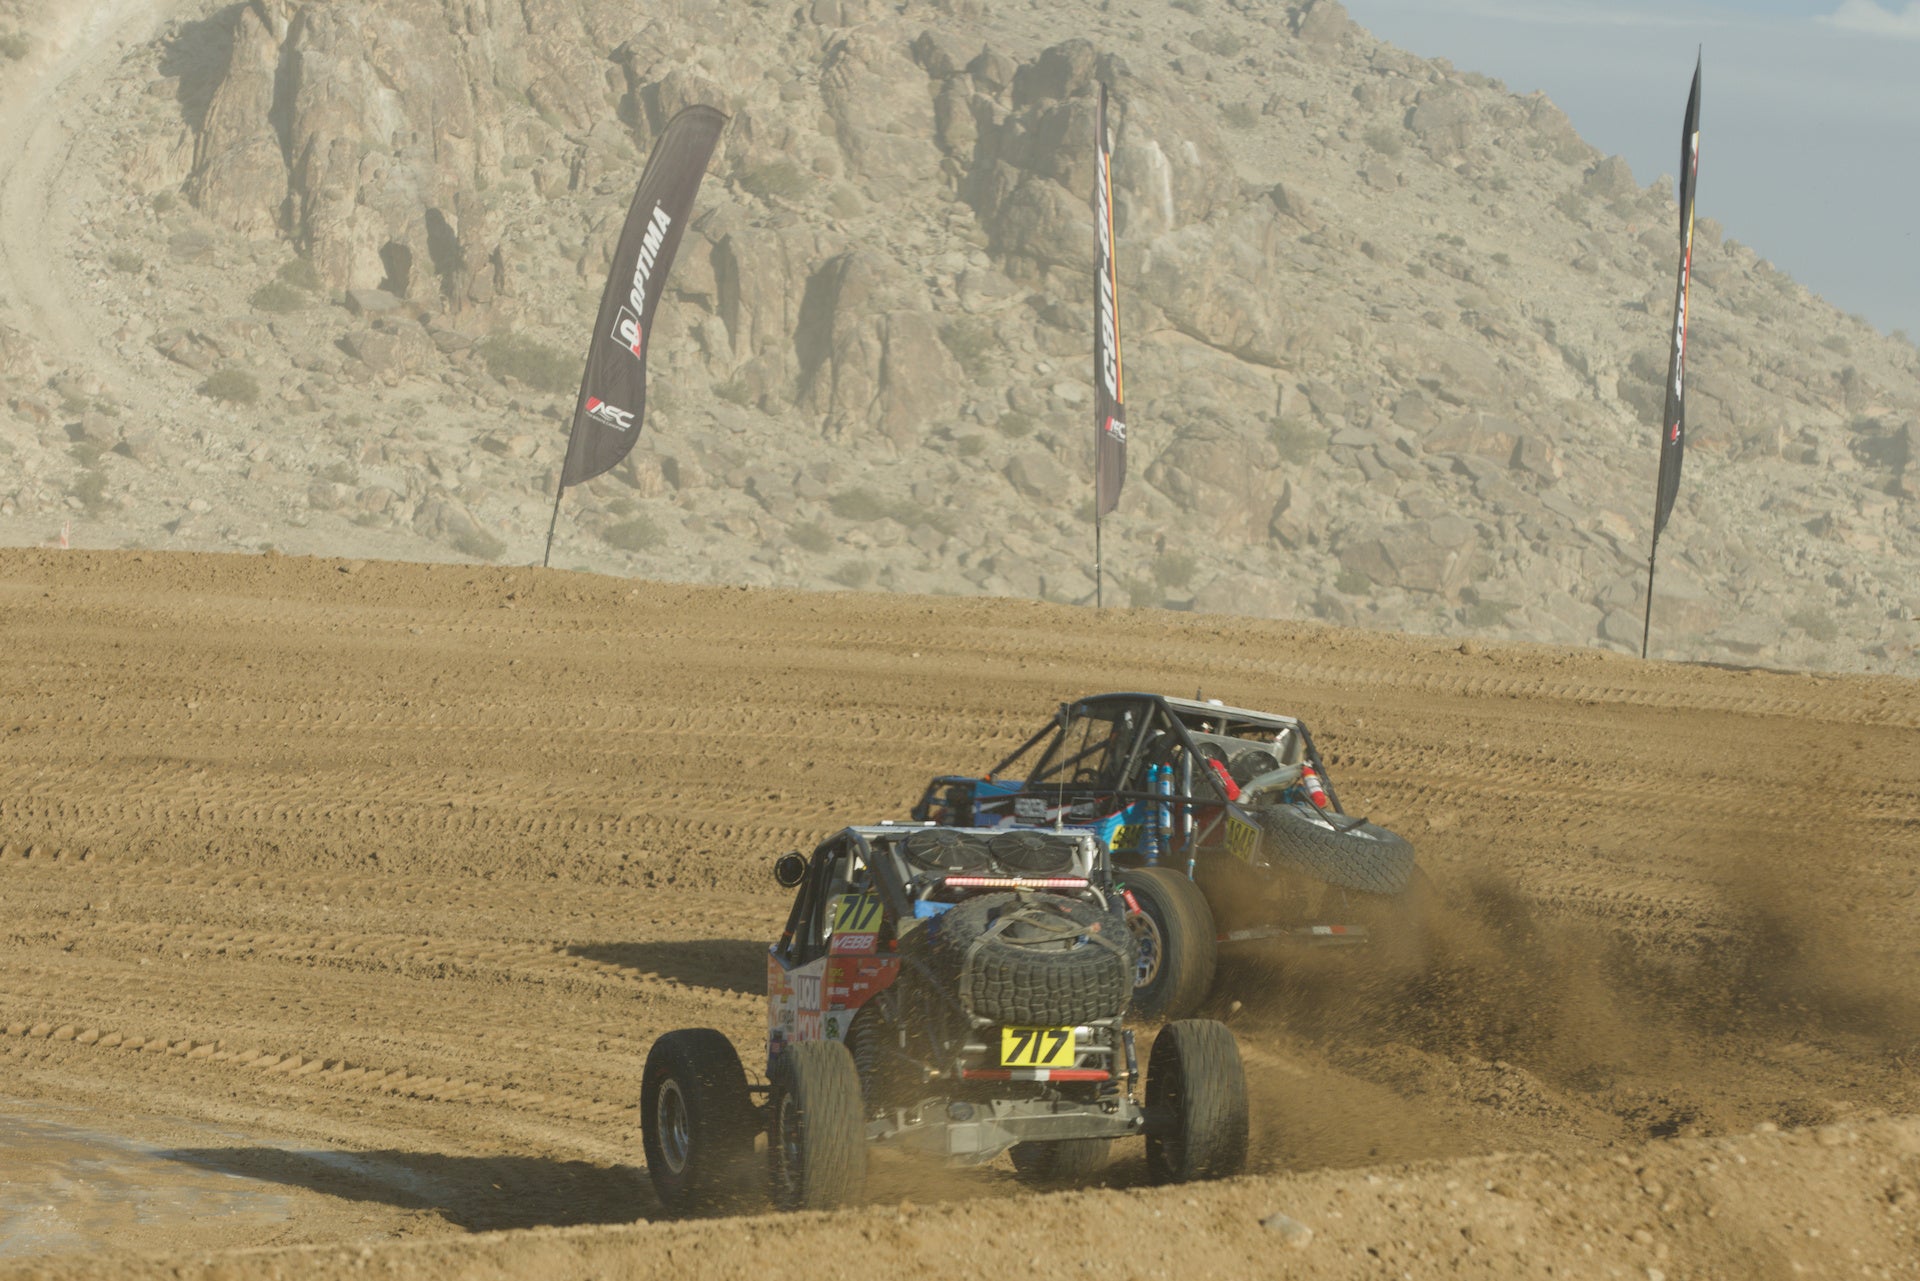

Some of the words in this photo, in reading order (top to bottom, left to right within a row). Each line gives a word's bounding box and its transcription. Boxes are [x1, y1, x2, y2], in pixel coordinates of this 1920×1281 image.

[629, 205, 672, 317] OPTIMA
[837, 895, 881, 930] 717
[832, 935, 875, 950] WEBB
[1004, 1028, 1070, 1064] 717
